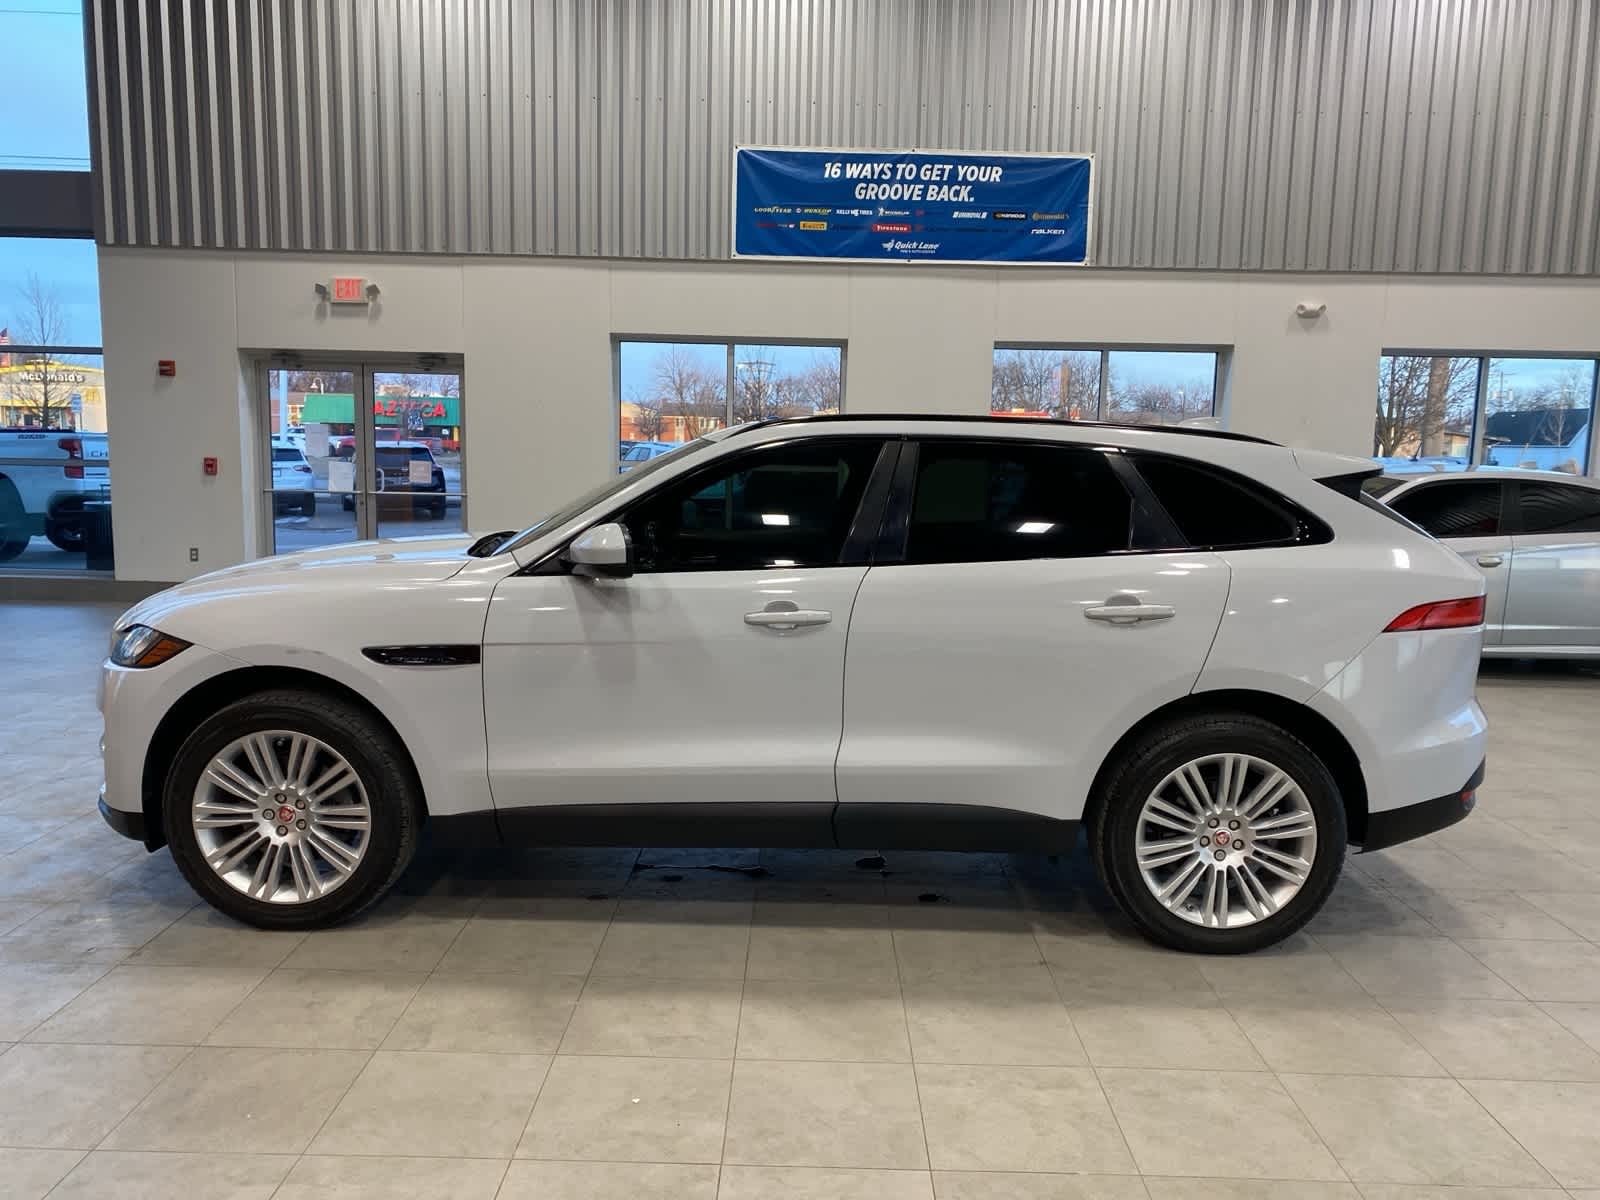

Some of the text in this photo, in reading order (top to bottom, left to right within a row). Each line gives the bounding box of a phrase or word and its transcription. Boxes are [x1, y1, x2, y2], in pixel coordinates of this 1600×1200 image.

[824, 162, 1003, 182] 16 WAYS TO GET YOUR
[855, 183, 975, 202] GROOVE BACK.
[754, 206, 793, 214] GOODYEAR
[894, 241, 939, 250] Quick Lane
[336, 278, 362, 299] EXIT
[21, 372, 84, 383] McDonald's
